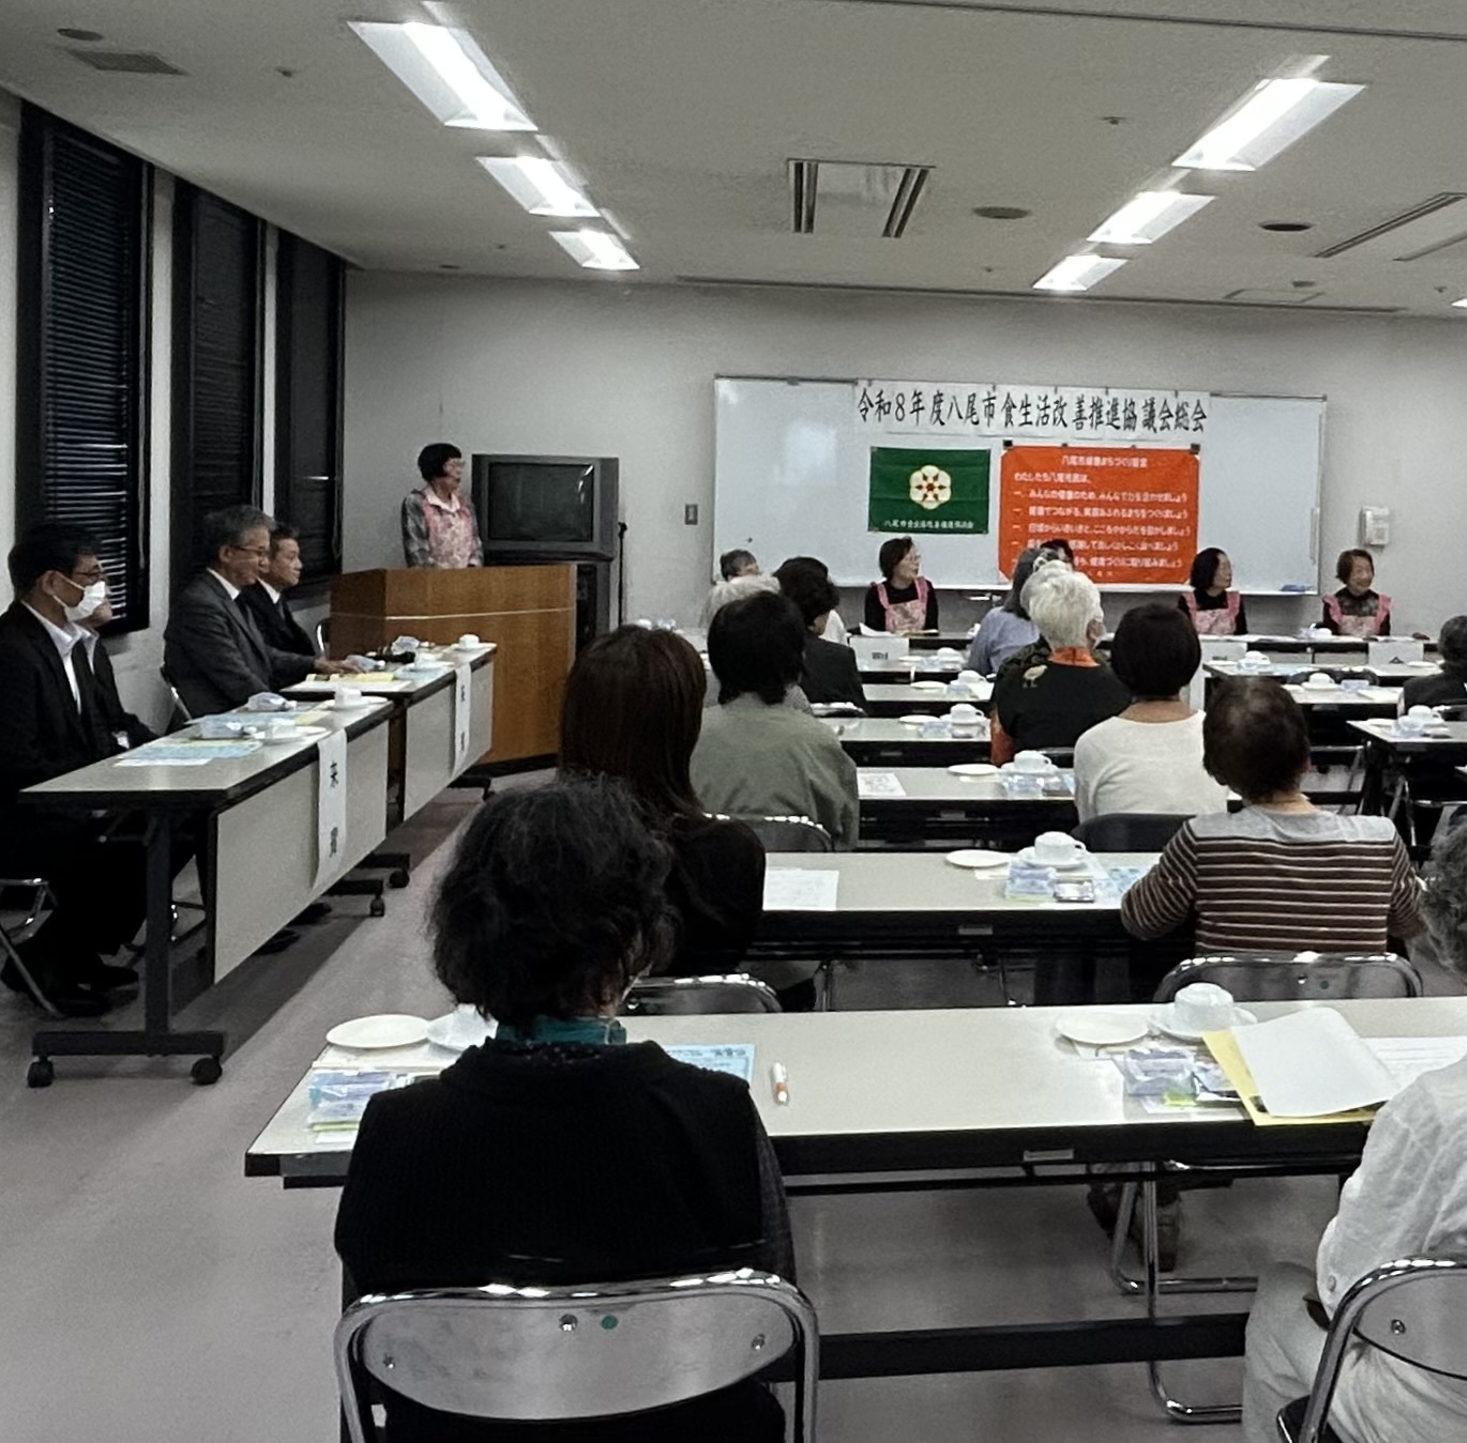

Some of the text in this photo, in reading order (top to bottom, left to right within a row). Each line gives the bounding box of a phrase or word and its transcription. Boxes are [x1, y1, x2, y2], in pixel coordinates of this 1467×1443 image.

[857, 387, 1207, 433] 令和8年度八尾市食生活改善推進協議会総会
